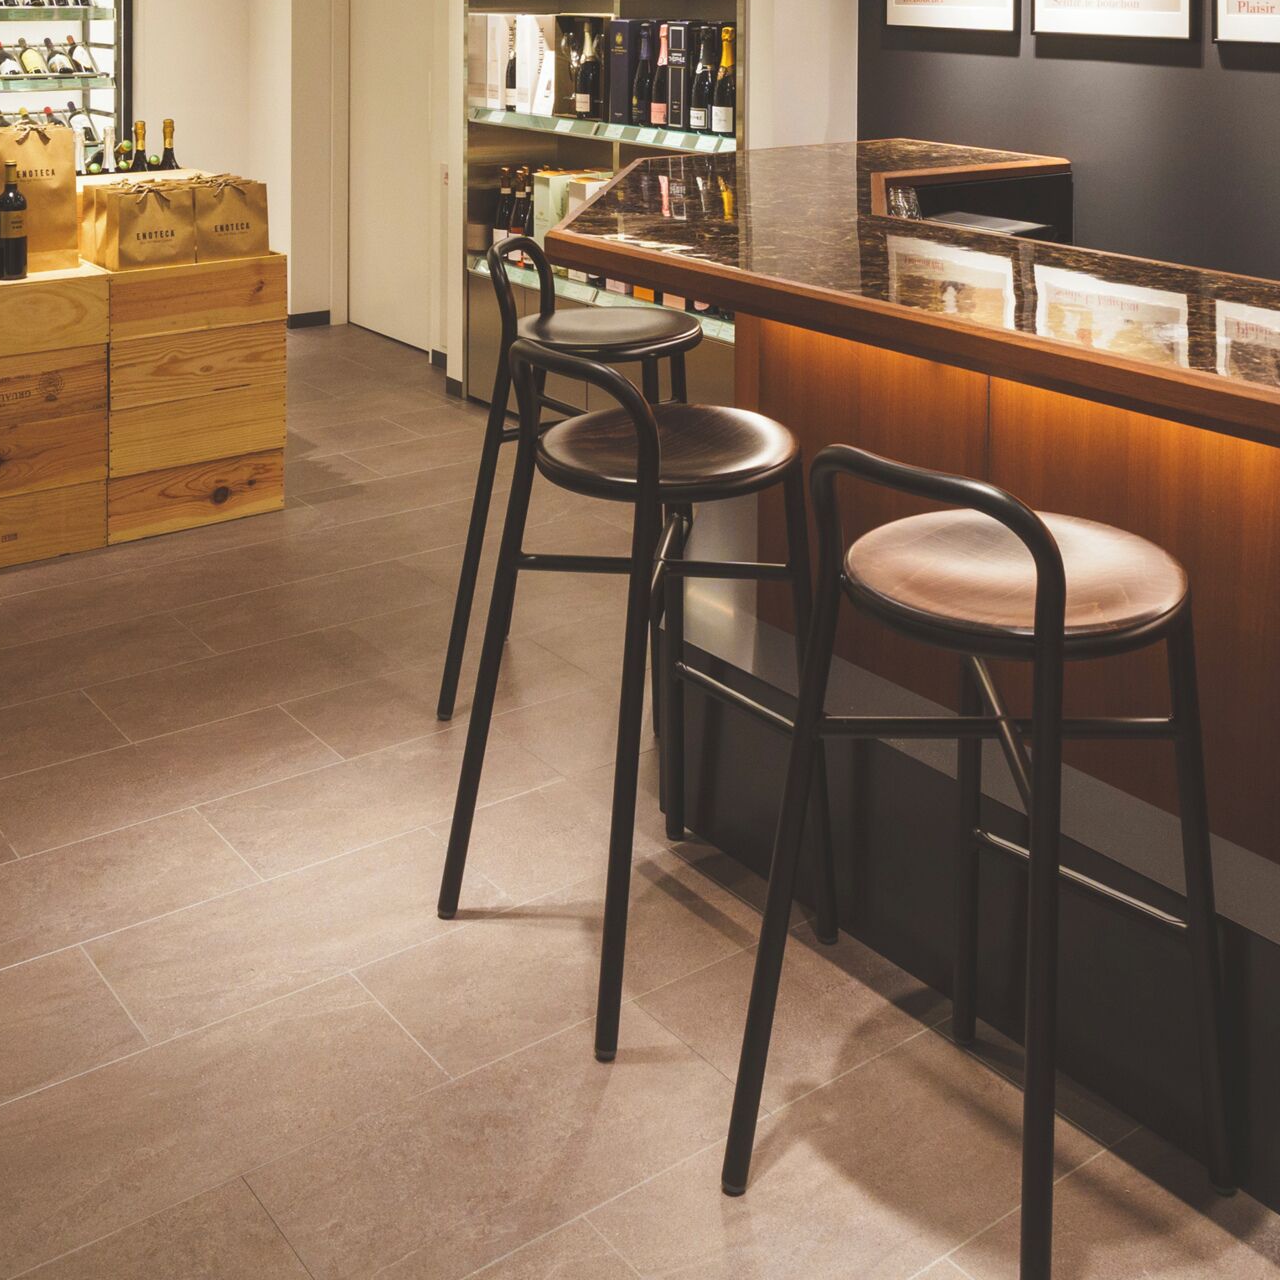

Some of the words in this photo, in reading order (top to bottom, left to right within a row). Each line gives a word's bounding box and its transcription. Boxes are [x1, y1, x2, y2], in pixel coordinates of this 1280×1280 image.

[1237, 1, 1275, 14] Plaisir
[16, 168, 56, 178] ENOTECA
[214, 222, 250, 232] ENOTECA
[136, 230, 175, 240] ENOTECA
